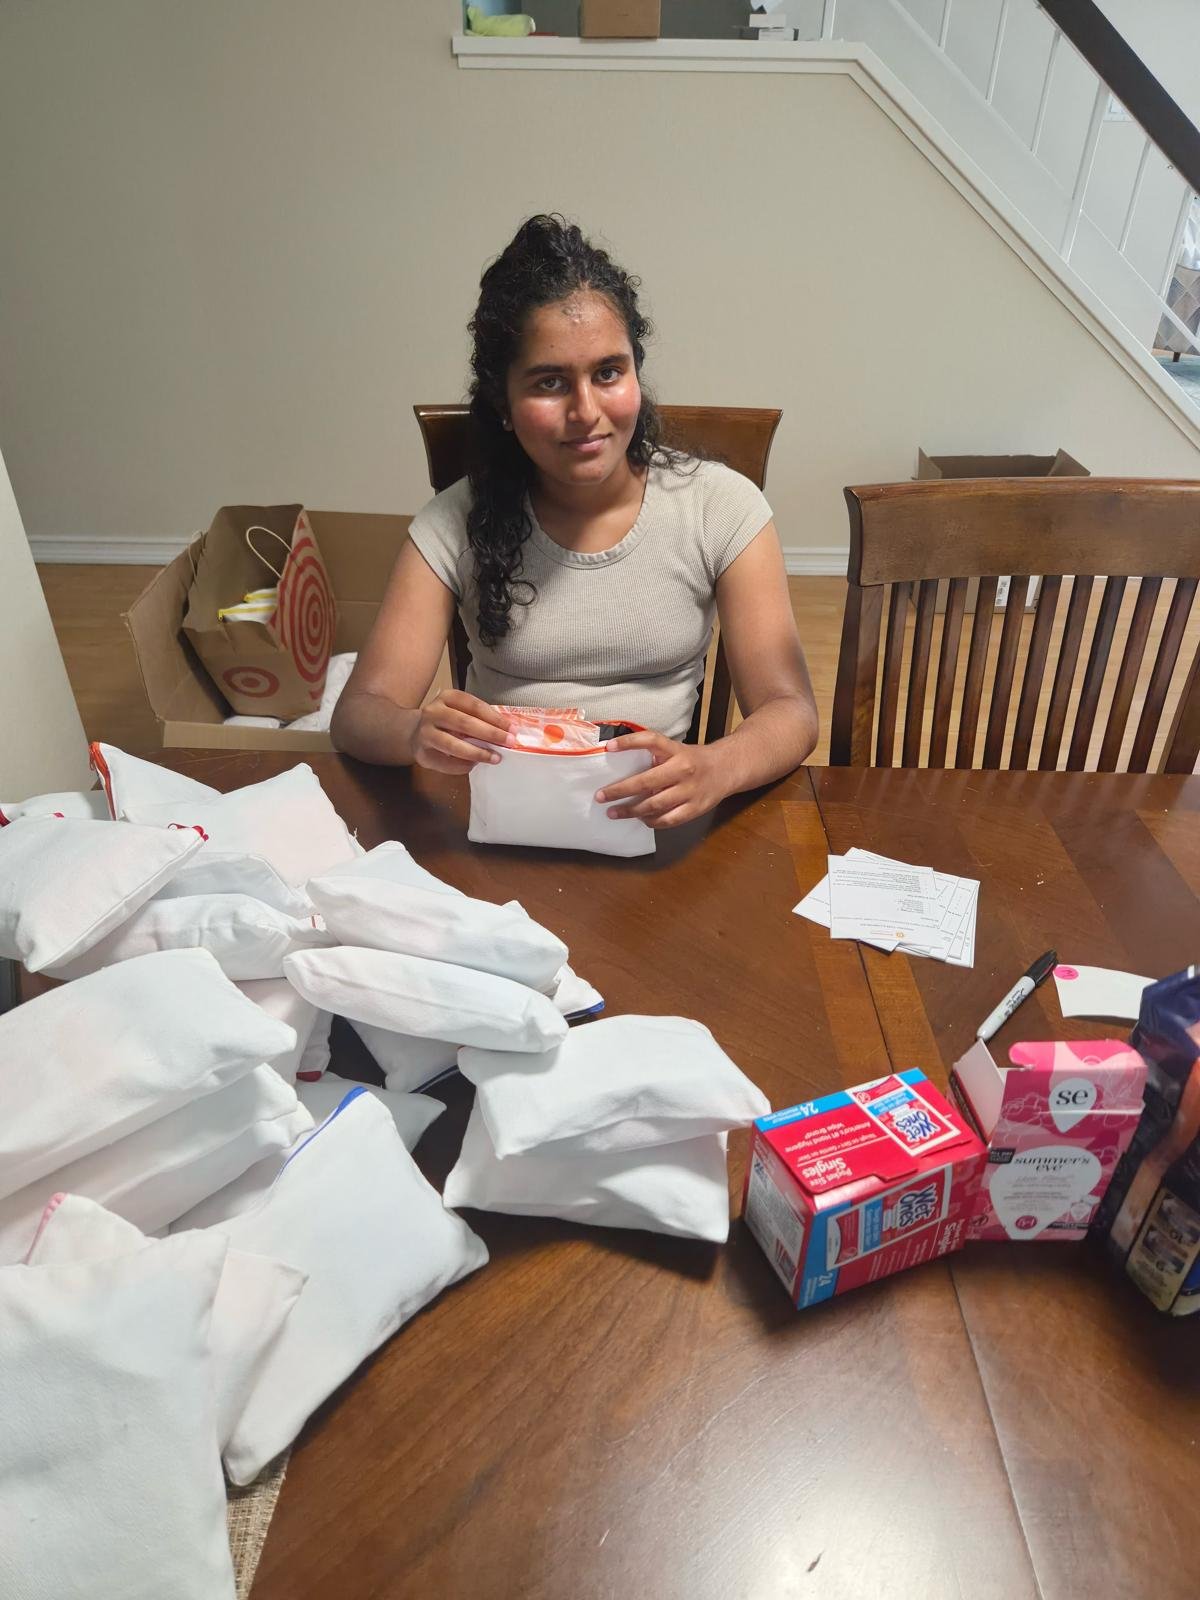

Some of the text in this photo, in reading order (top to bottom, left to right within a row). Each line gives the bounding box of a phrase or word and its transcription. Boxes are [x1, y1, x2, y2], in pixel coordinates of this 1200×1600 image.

[1056, 1089, 1088, 1105] se
[800, 1102, 819, 1117] 24
[896, 1110, 928, 1130] Ones
[906, 1121, 938, 1140] Wet
[801, 1157, 846, 1179] Singles
[809, 1167, 852, 1187] Pocket Size
[900, 1193, 919, 1228] Ones
[915, 1184, 936, 1219] Wet
